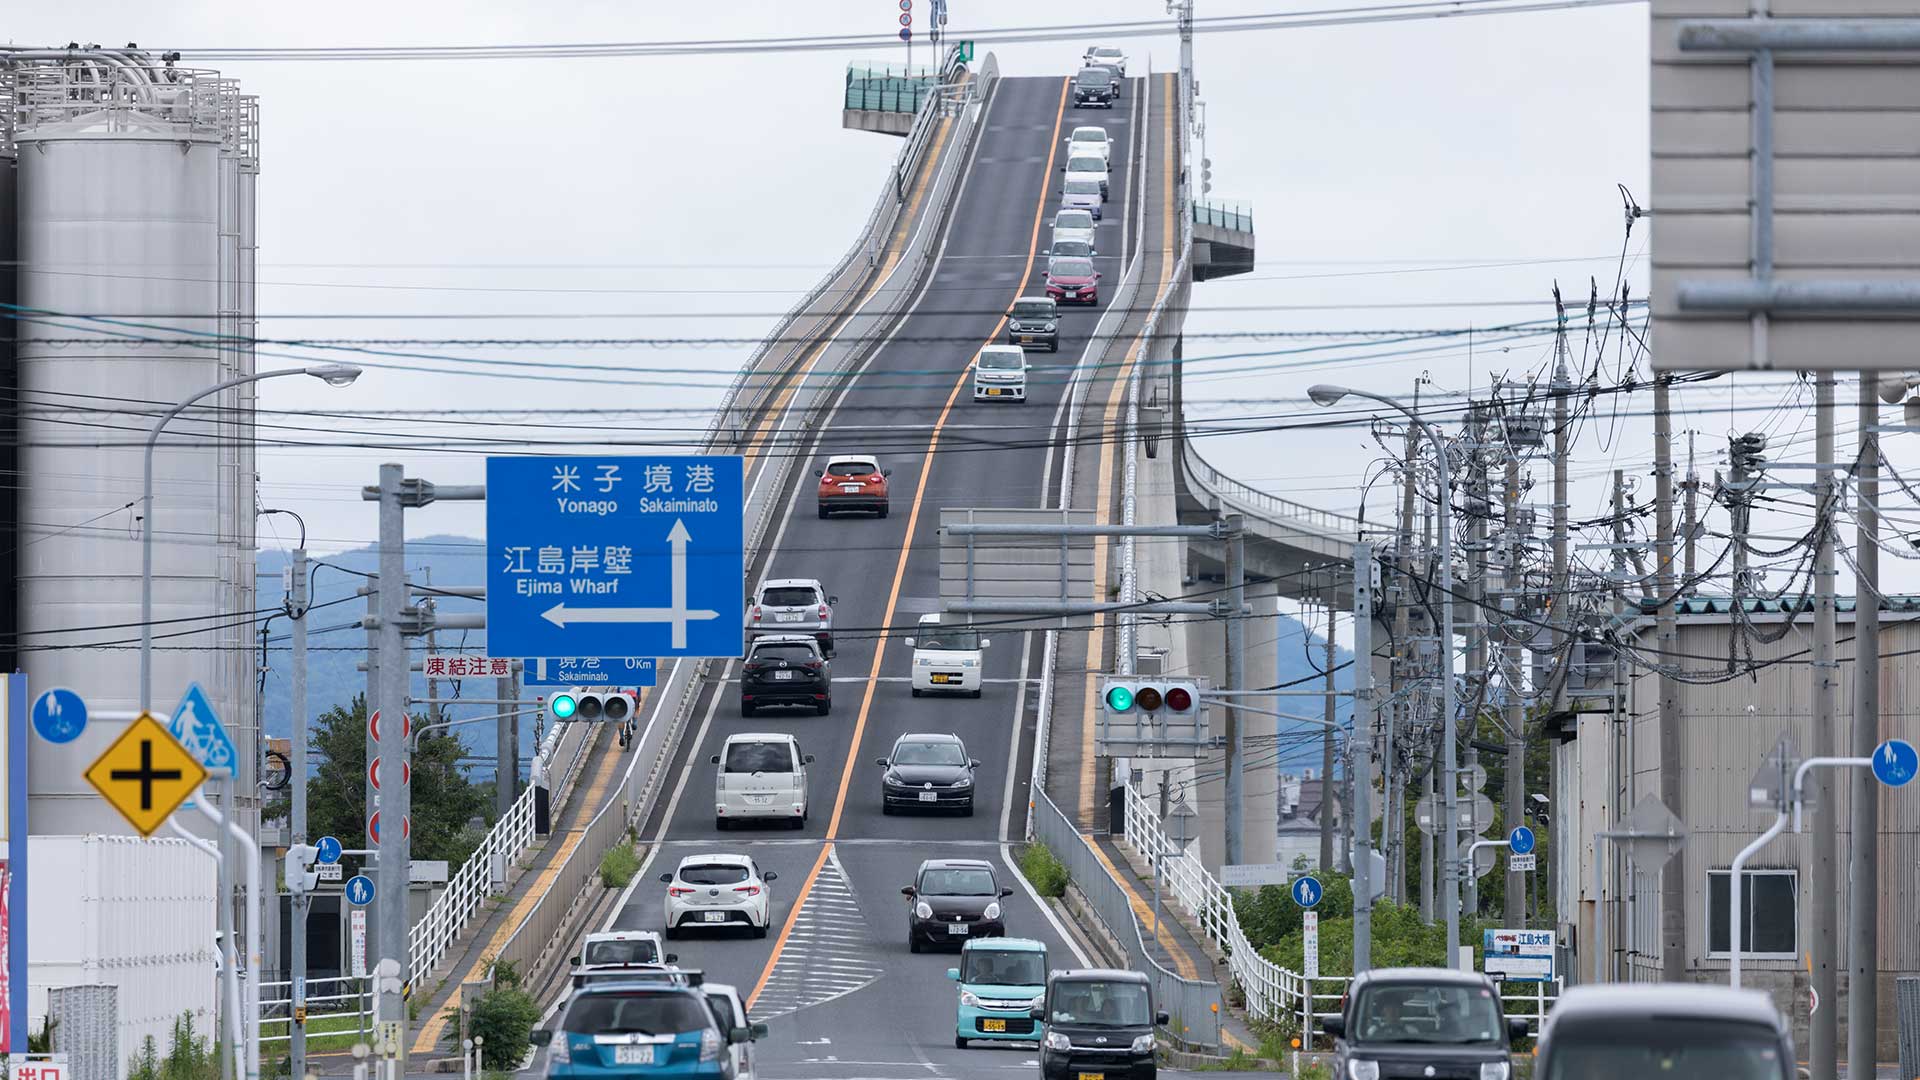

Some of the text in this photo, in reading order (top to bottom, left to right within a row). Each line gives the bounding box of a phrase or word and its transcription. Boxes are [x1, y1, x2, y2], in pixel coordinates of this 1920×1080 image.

[552, 464, 715, 493] 米子 境港
[557, 497, 718, 516] Yonago Sakaiminato
[503, 545, 632, 575] 江島岸壁
[517, 578, 619, 597] Ejima Wharf
[427, 657, 509, 676] 凍結注意
[558, 671, 608, 682] Sakaiminato
[1518, 933, 1550, 945] 江島大橋
[18, 1067, 60, 1080] 出口
